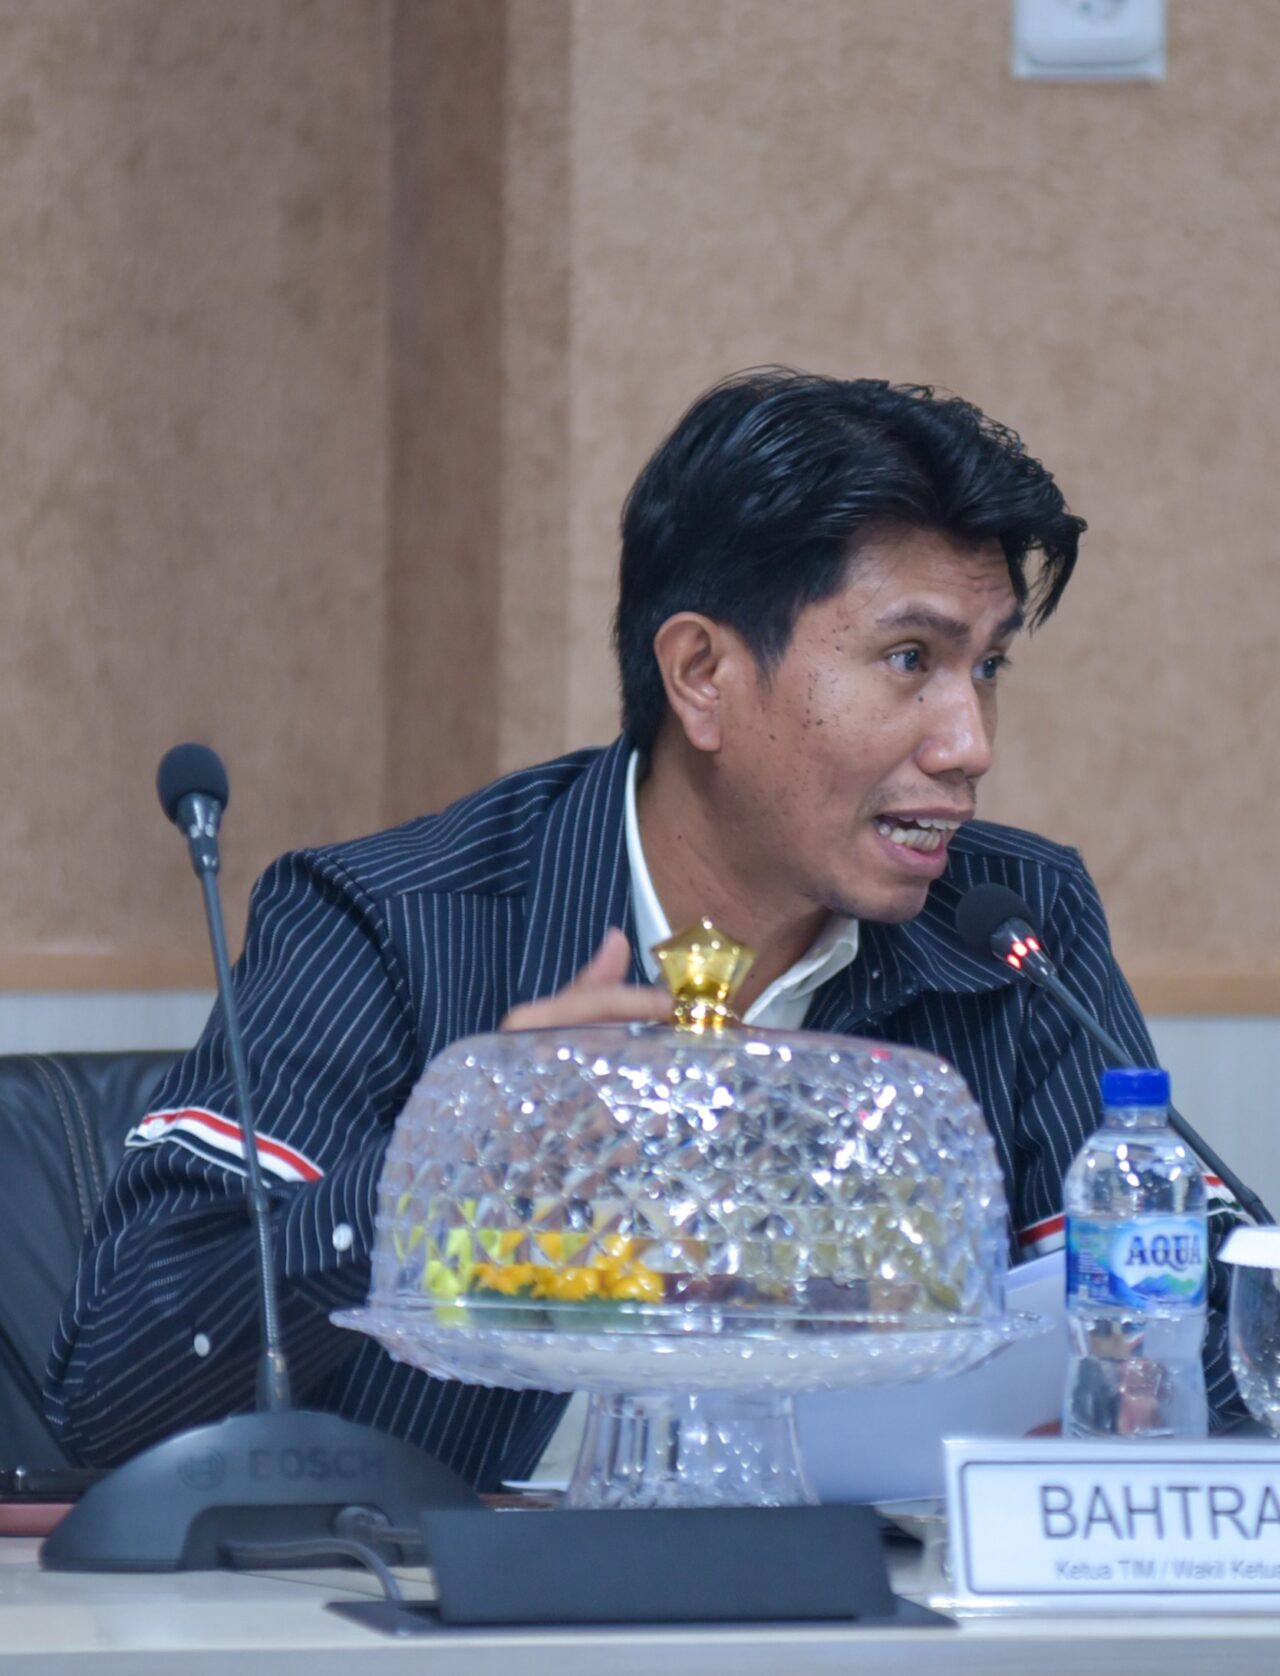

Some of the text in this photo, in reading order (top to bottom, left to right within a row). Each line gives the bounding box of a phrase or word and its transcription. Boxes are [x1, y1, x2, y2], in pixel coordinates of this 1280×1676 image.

[1125, 1234, 1202, 1271] AQUA
[1055, 1560, 1113, 1580] Ketua
[1117, 1560, 1155, 1580] TIM
[1172, 1560, 1226, 1580] Wakil
